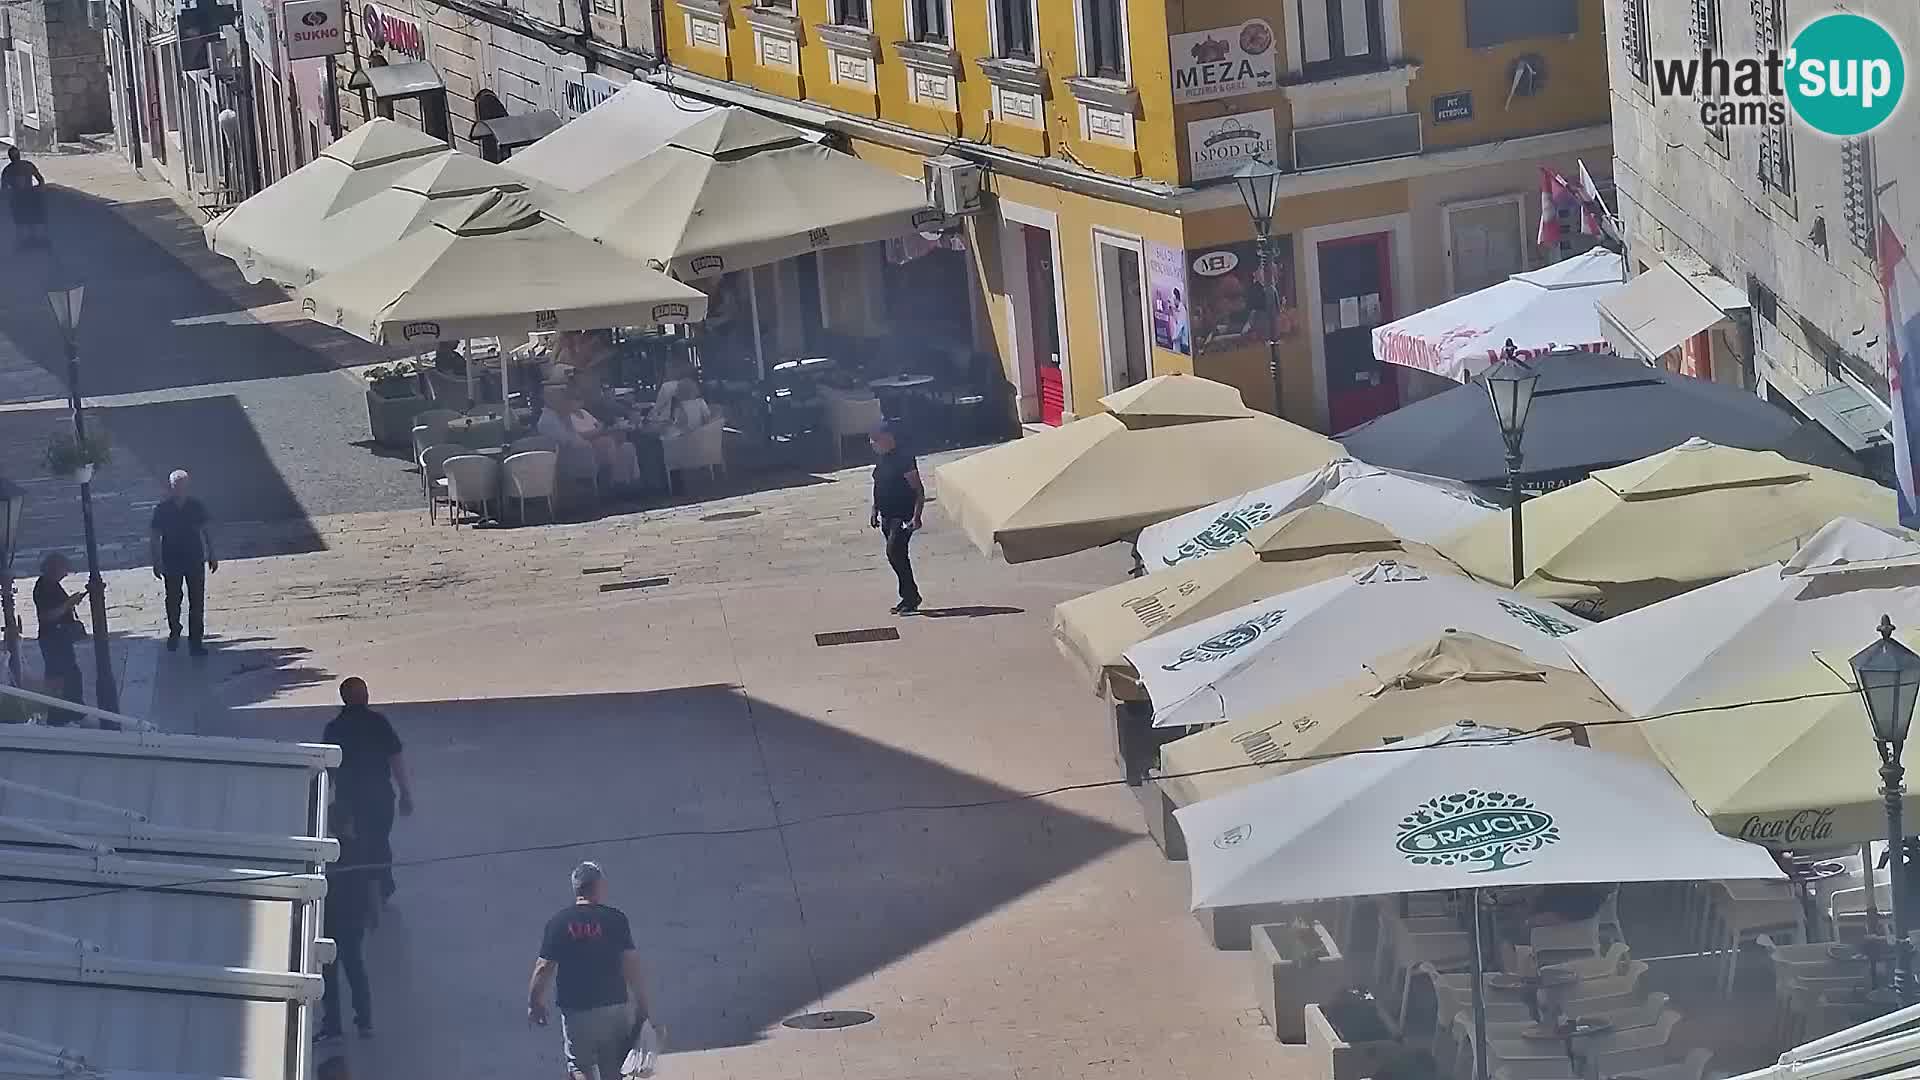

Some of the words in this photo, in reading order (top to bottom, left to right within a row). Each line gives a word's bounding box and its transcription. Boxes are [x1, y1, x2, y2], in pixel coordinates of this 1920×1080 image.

[294, 27, 338, 42] SUKNO
[381, 13, 420, 50] SUKNO
[1176, 59, 1255, 89] MEZA
[1194, 145, 1240, 163] ISPOD
[1436, 814, 1535, 845] RAUCH
